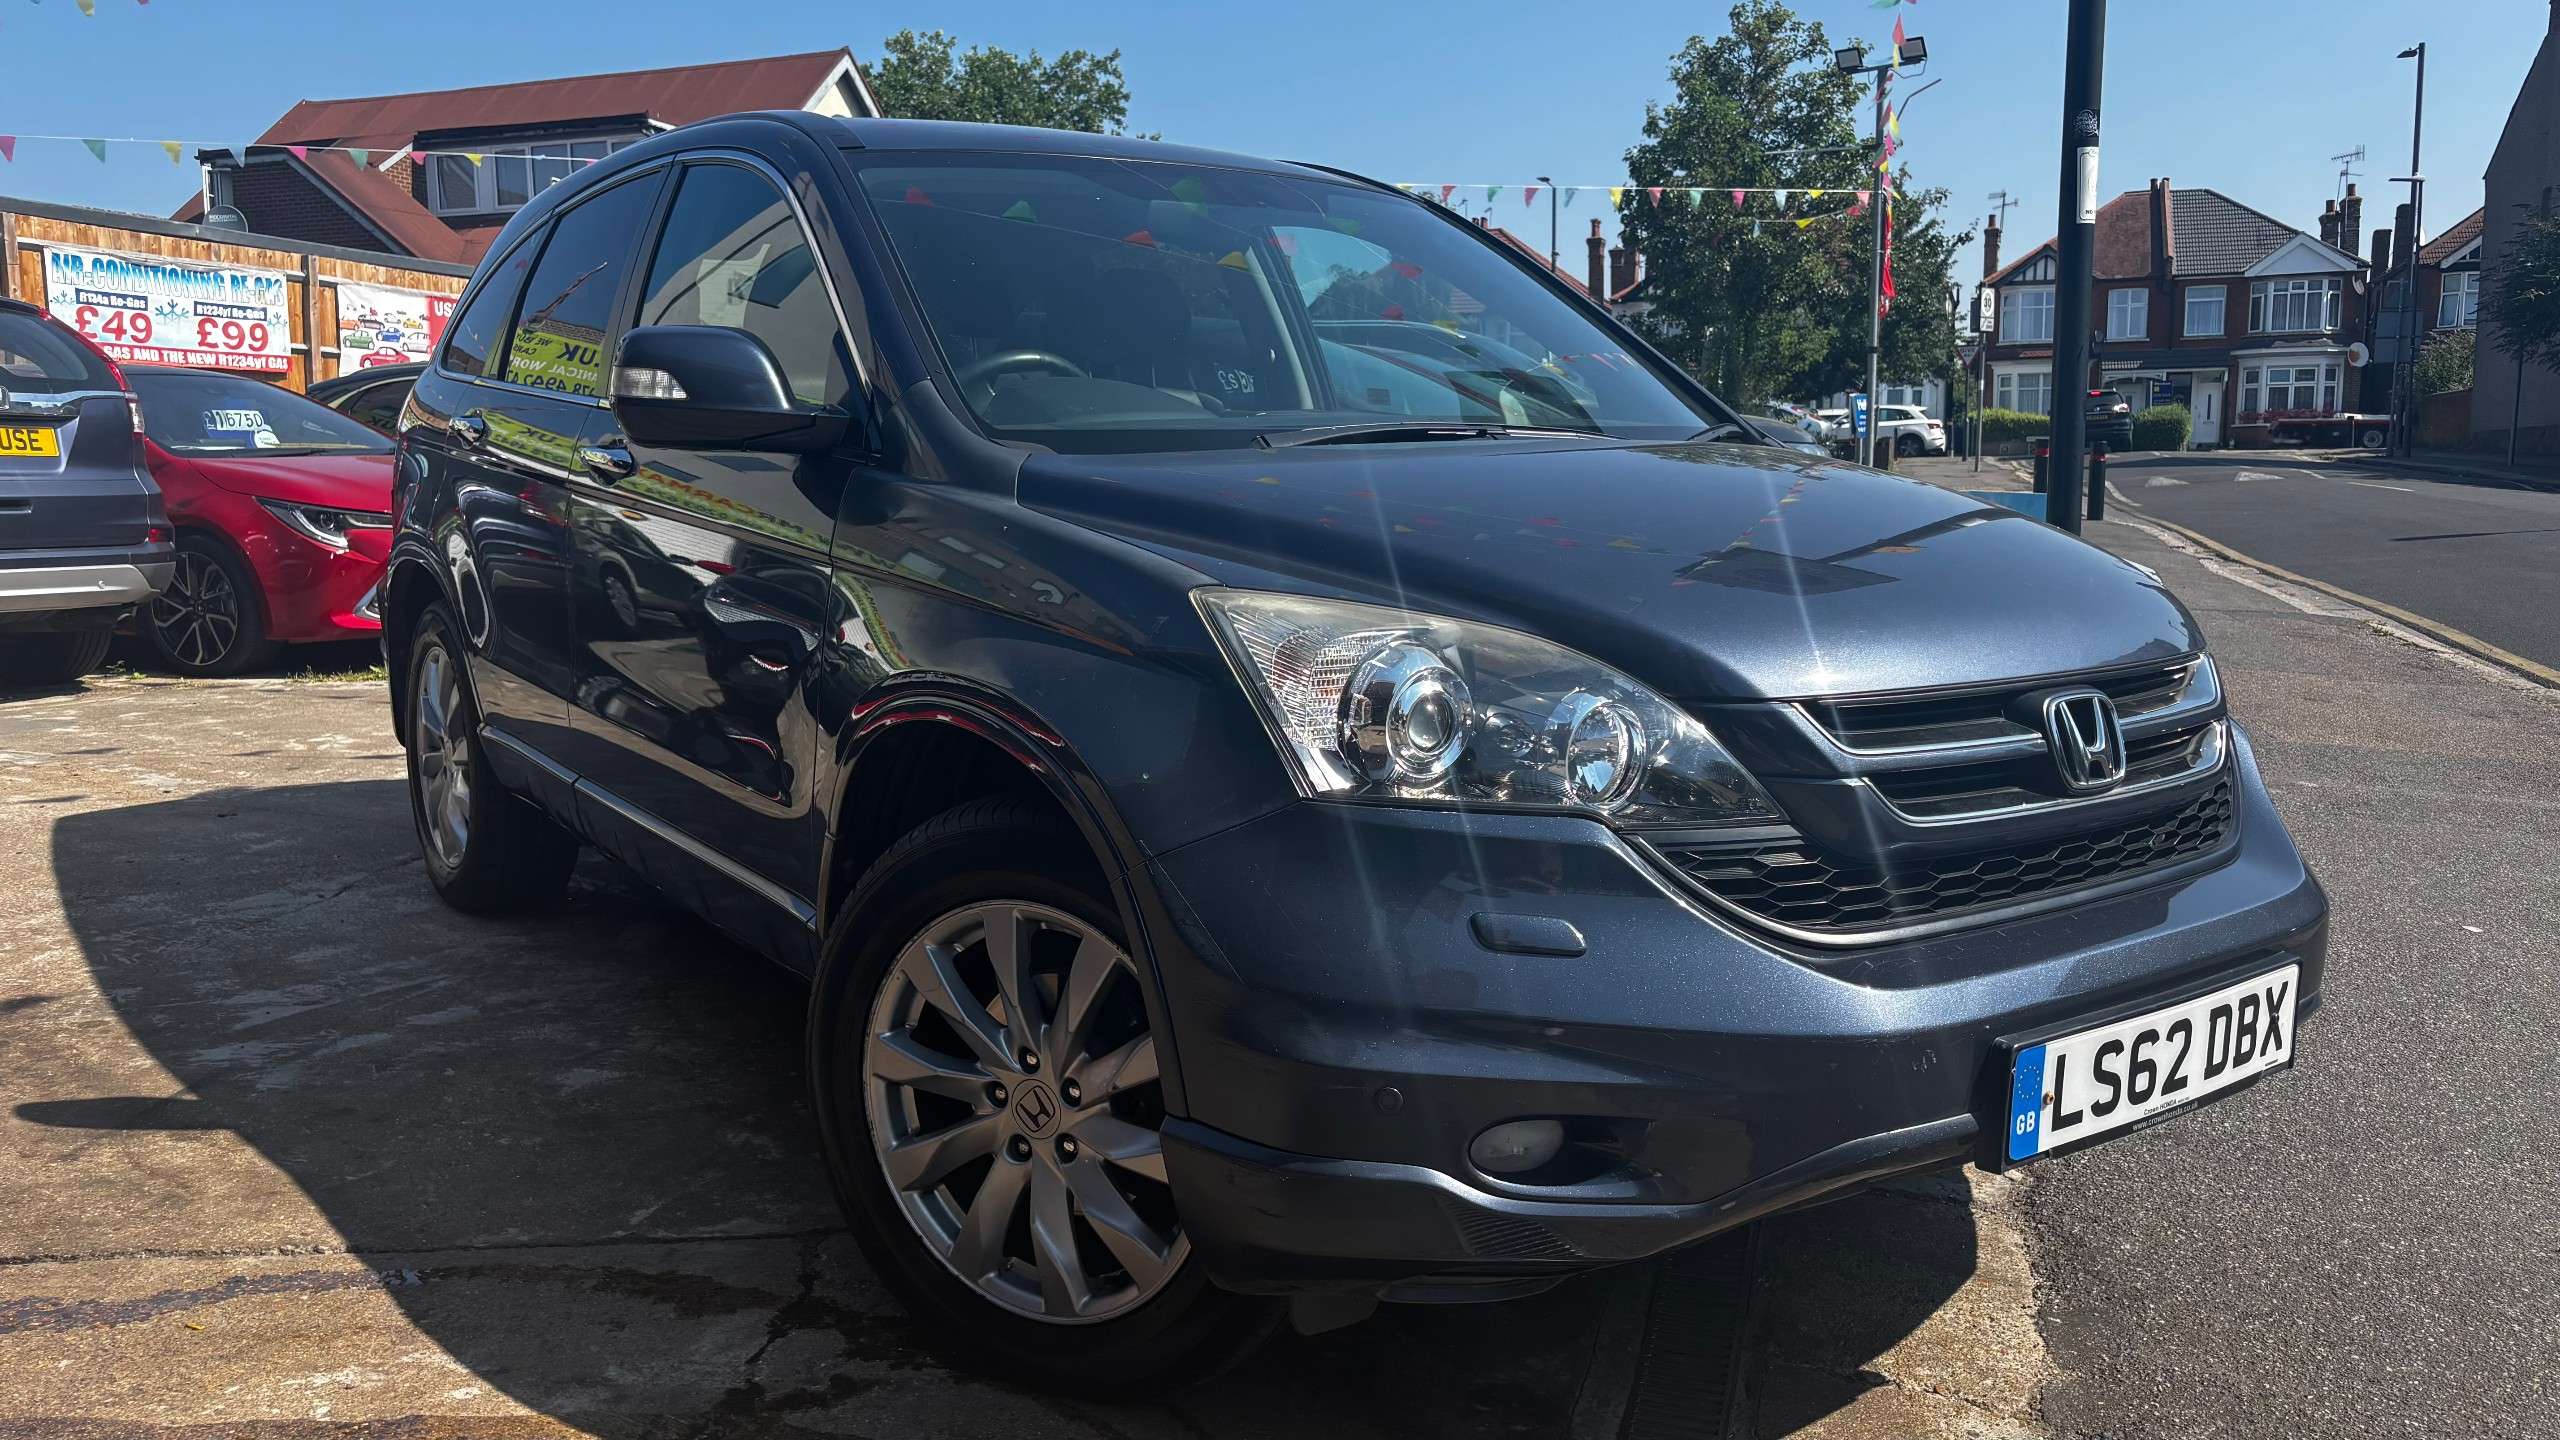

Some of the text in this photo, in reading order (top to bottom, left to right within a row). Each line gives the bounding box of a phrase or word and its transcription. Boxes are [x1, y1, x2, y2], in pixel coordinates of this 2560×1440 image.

[52, 252, 285, 306] AIR-CONDITIONING RE-GAS
[110, 295, 146, 309] Re-Gas
[232, 305, 265, 319] Re-Gas
[434, 300, 455, 318] US
[1983, 298, 1993, 308] 30
[75, 305, 153, 344] £49
[197, 317, 269, 352] £99
[133, 348, 160, 362] AND
[162, 350, 186, 364] THE
[187, 352, 216, 367] NEW
[2051, 981, 2289, 1132] LS62 DBX
[2016, 1111, 2036, 1136] GB
